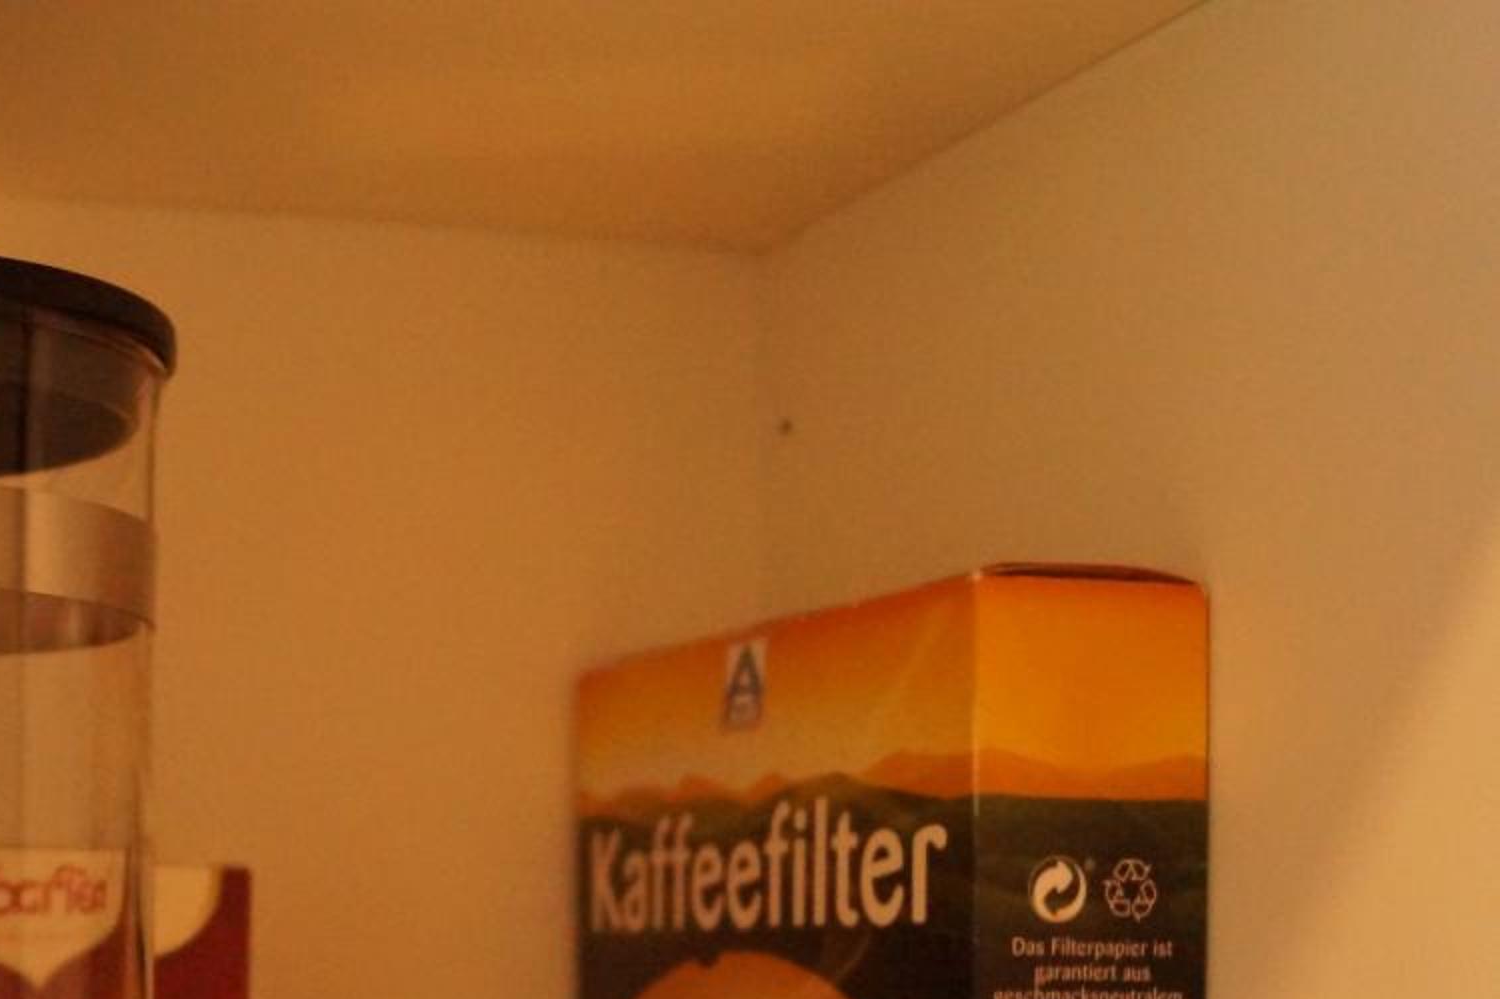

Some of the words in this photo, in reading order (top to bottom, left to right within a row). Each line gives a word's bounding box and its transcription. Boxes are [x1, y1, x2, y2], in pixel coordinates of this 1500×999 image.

[591, 796, 947, 931] Kaffeefilter
[1012, 936, 1044, 957] Das
[1051, 937, 1148, 960] Filterpapier
[1153, 938, 1172, 958] ist
[1034, 964, 1117, 986] garantiert
[1123, 966, 1151, 982] aus
